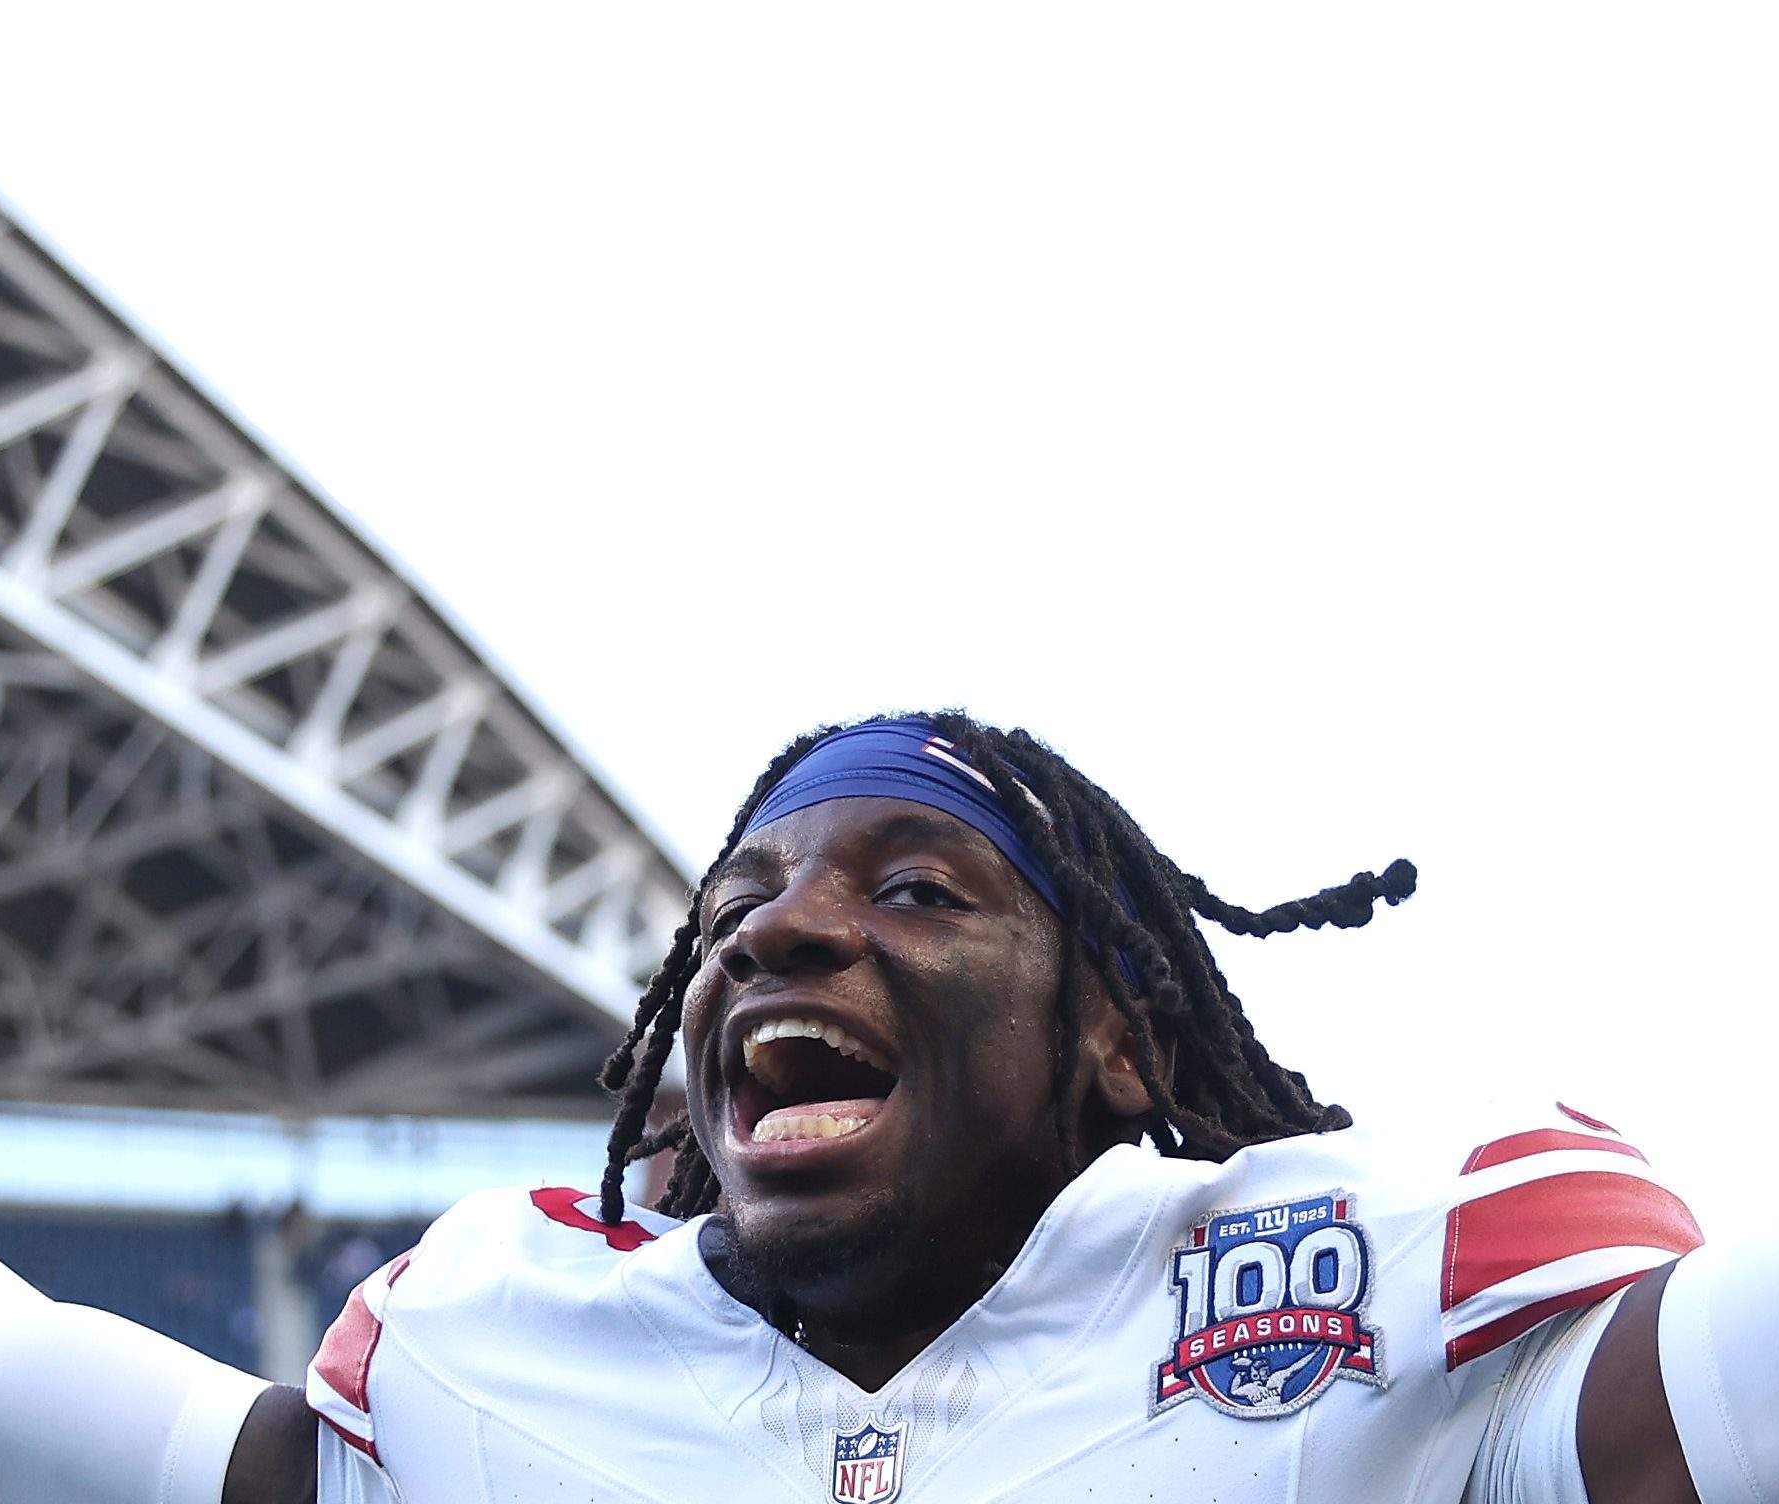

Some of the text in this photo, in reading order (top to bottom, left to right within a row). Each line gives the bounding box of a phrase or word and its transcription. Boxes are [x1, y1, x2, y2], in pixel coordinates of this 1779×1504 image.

[1219, 1205, 1328, 1238] EST. ny 1925
[1175, 1226, 1366, 1336] 100
[1189, 1315, 1343, 1358] SEASONS
[837, 1460, 891, 1500] NFL
